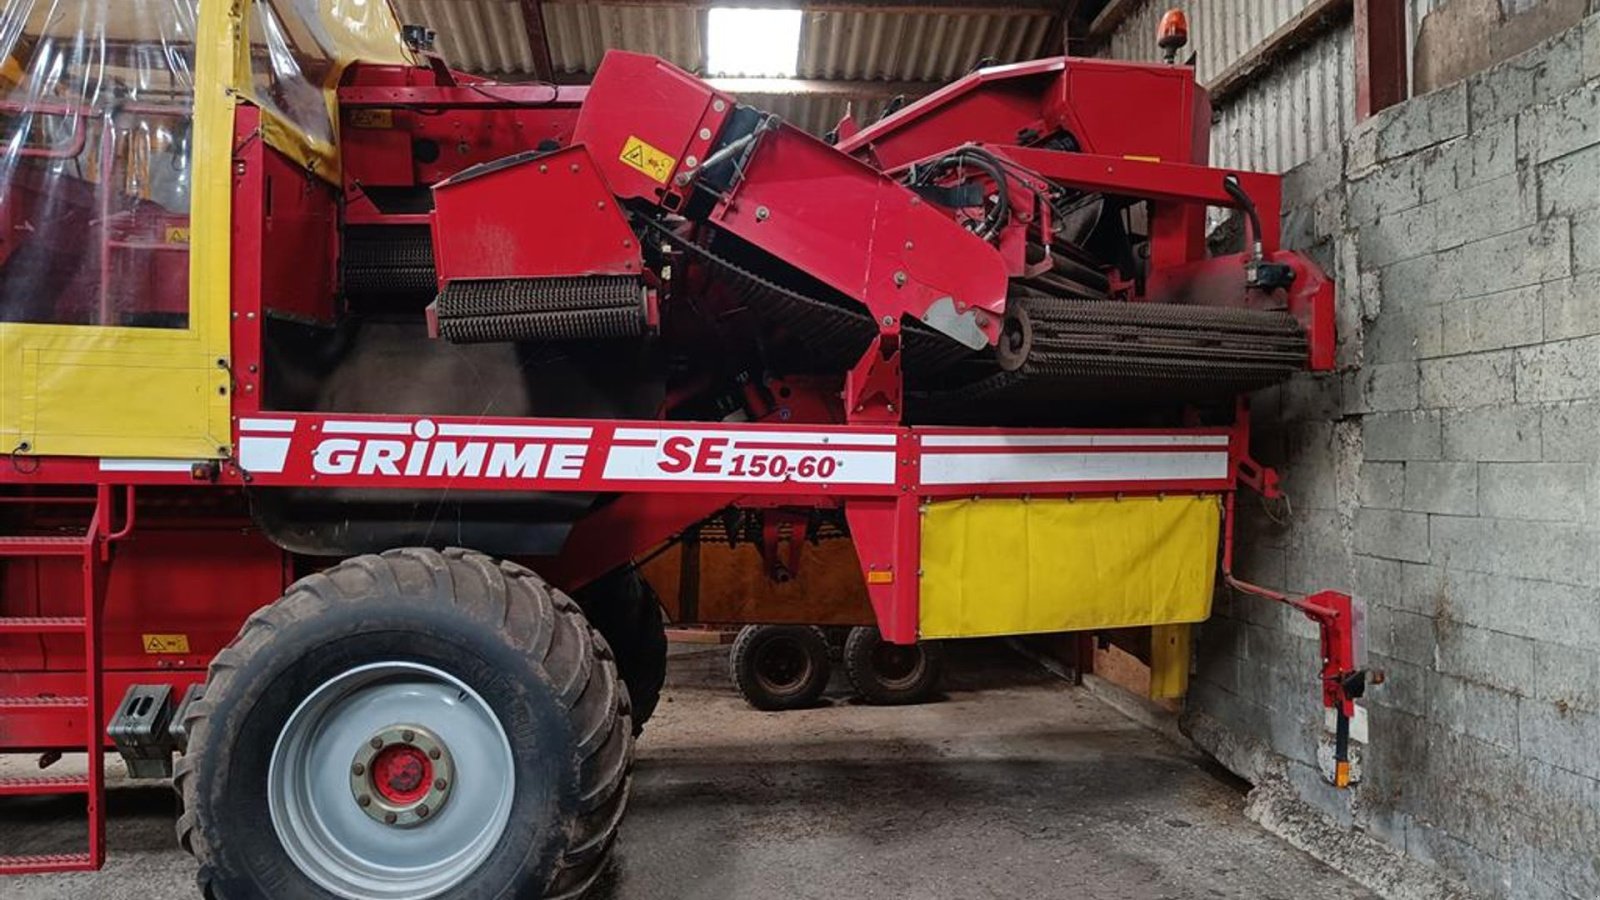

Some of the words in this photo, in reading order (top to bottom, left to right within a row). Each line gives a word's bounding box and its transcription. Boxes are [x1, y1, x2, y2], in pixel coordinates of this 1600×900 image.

[313, 419, 589, 479] GRIMME
[657, 436, 729, 473] SE
[728, 454, 836, 478] 150-60
